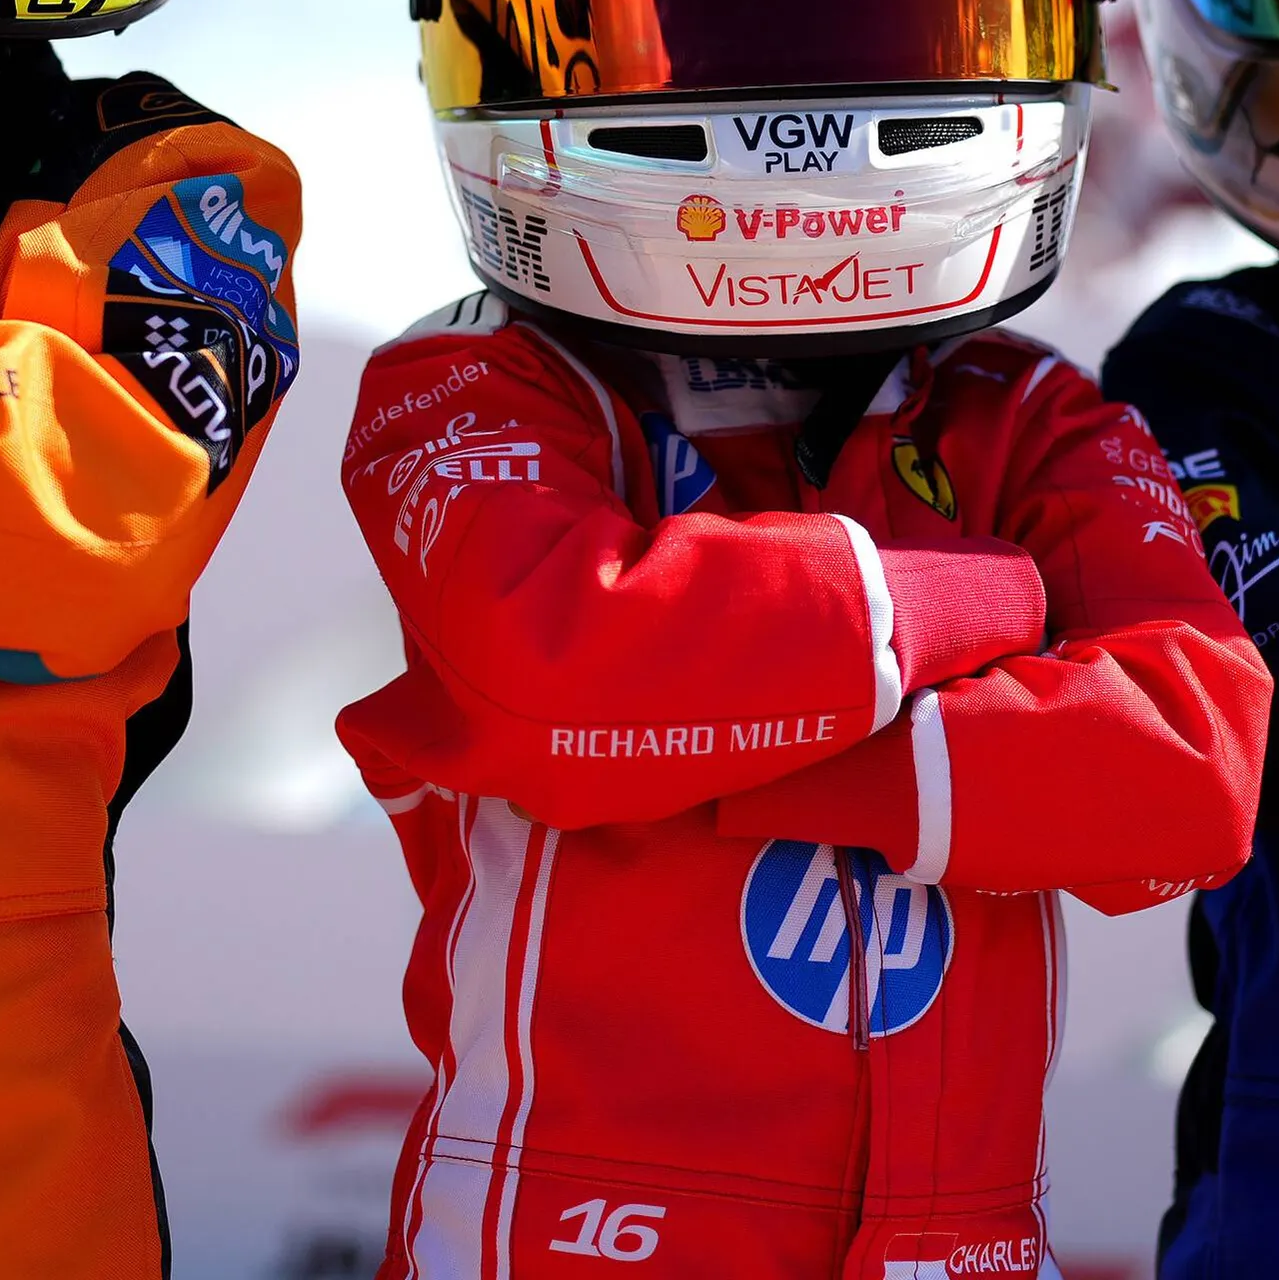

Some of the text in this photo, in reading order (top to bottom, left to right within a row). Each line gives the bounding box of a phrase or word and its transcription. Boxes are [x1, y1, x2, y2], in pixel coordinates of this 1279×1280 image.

[733, 113, 854, 152] VGW
[765, 151, 839, 173] PLAY
[461, 183, 551, 293] IBM
[733, 202, 907, 241] V-Power
[210, 266, 265, 309] IRON
[551, 715, 838, 759] RICHARD MILLE
[548, 1197, 667, 1262] 16
[949, 1236, 1037, 1274] CHARLES
